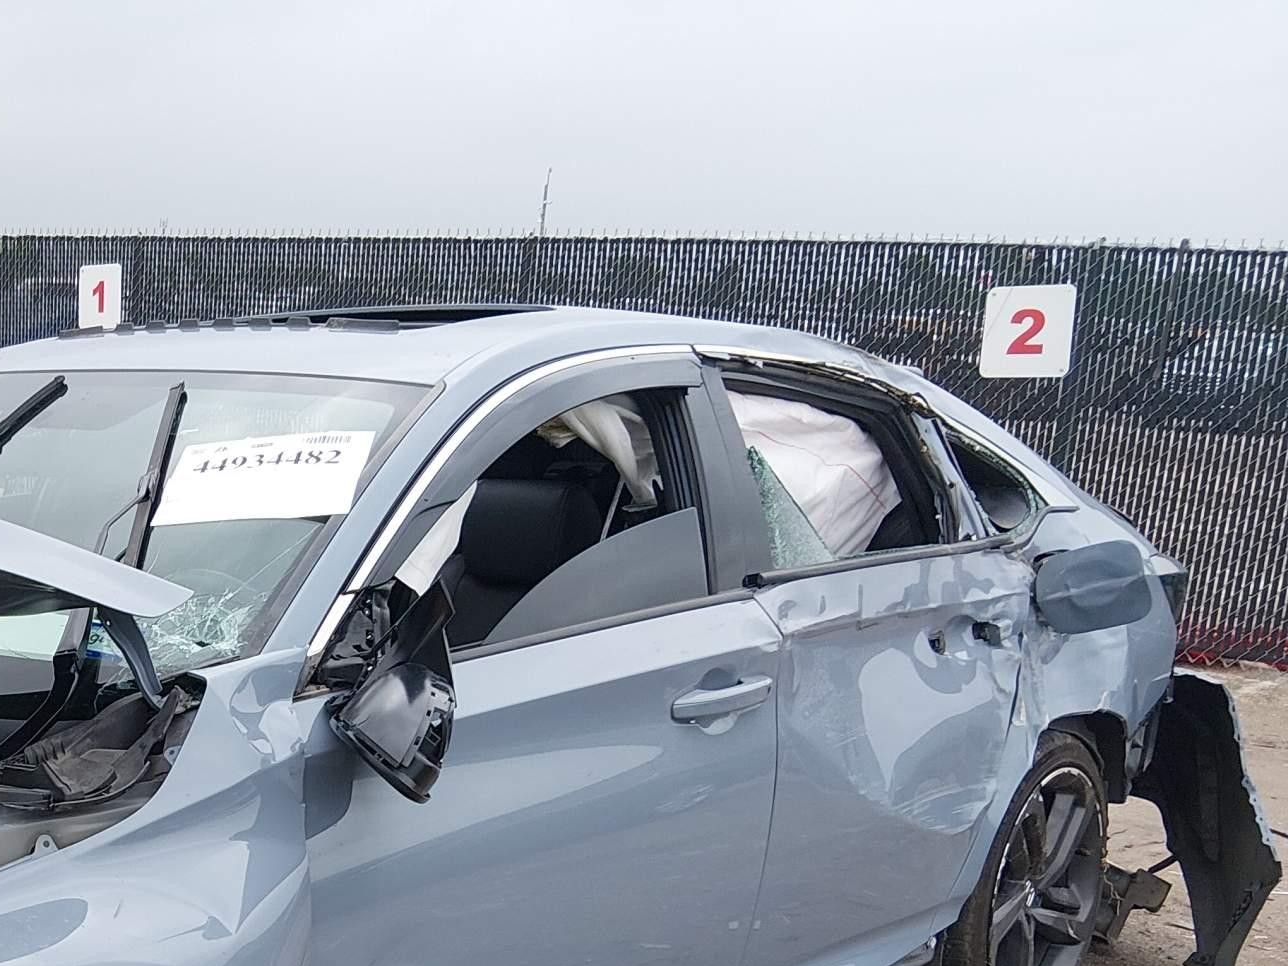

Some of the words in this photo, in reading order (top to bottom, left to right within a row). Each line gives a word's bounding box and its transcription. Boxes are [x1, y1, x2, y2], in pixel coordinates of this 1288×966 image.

[92, 281, 104, 313] 1
[1006, 309, 1045, 354] 2
[192, 449, 341, 473] 44934482
